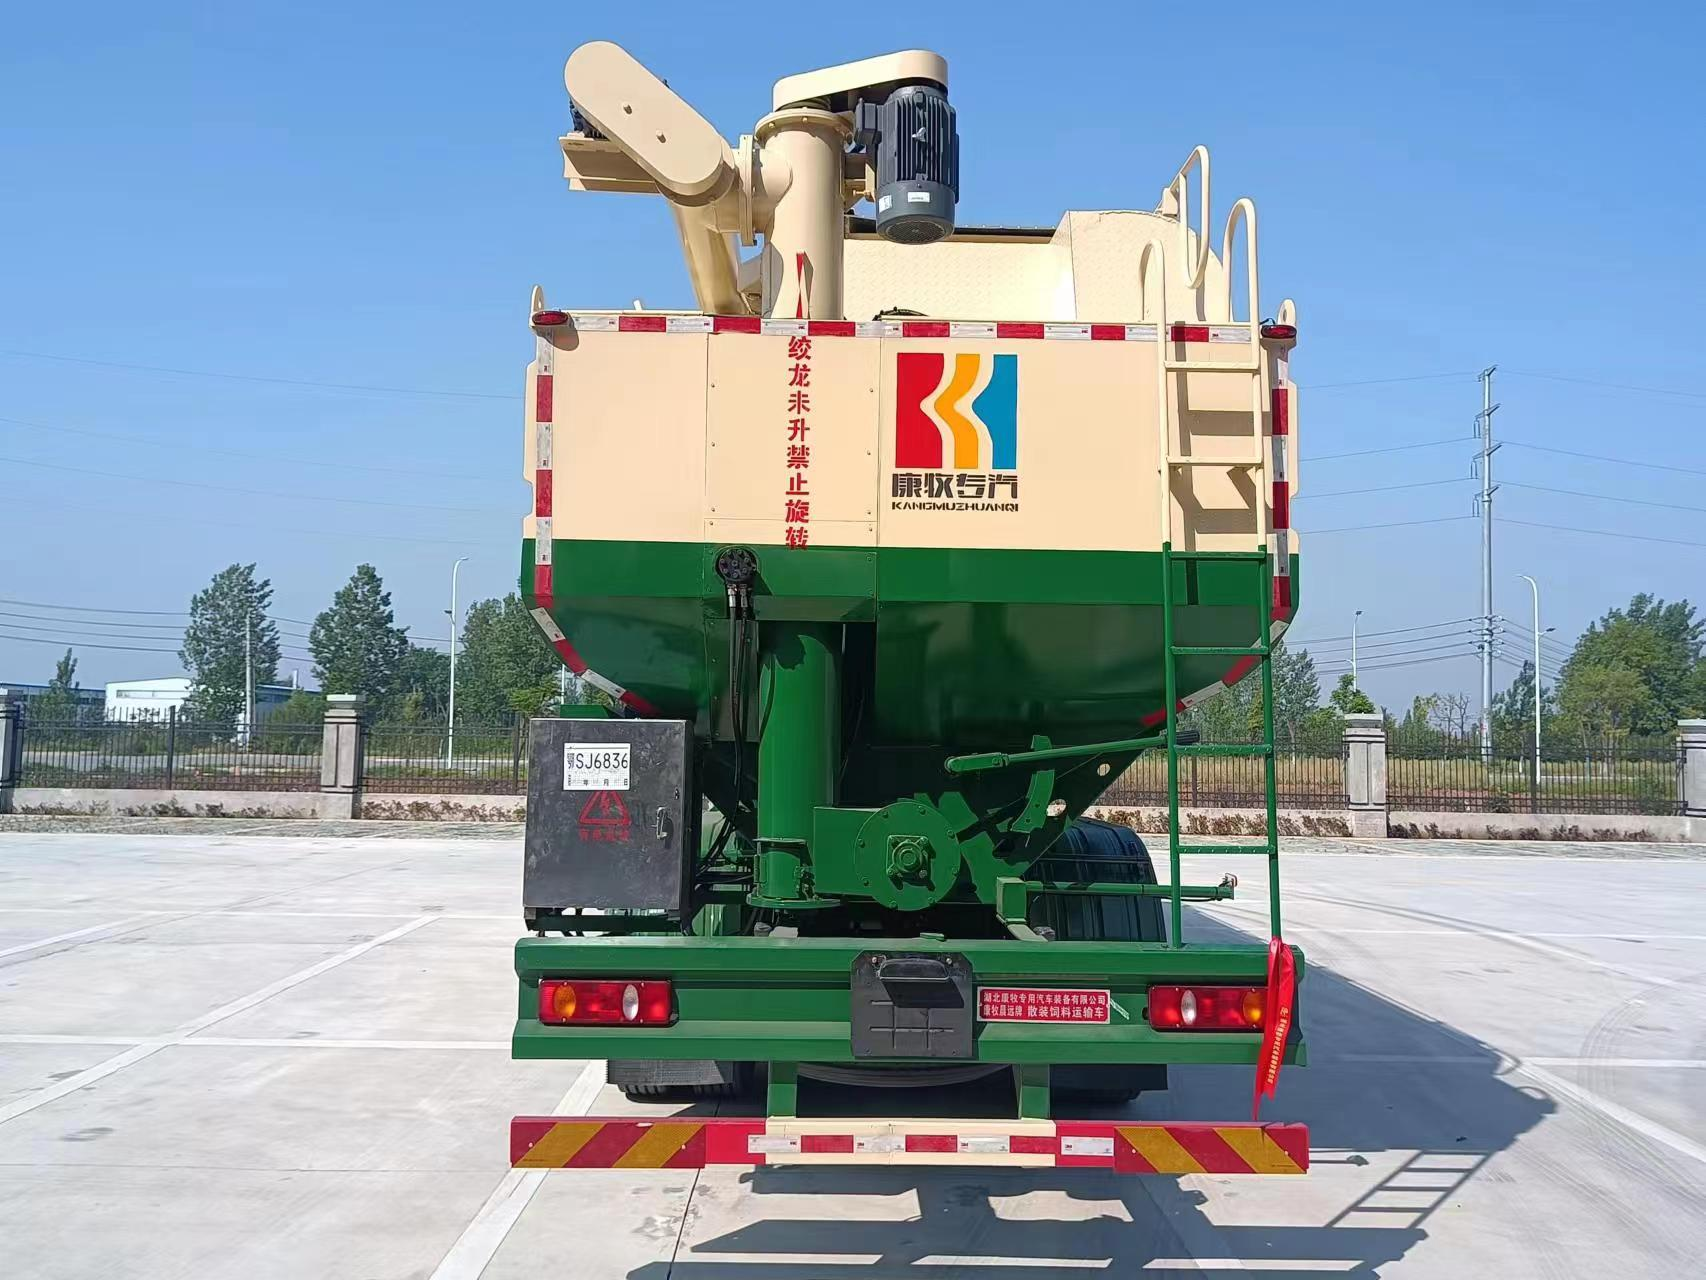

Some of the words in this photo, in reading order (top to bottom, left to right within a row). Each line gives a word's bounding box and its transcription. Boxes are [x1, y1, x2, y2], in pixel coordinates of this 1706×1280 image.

[785, 335, 812, 551] 绞龙未升禁止旋转
[891, 472, 1018, 499] 康牧专汽
[891, 501, 1019, 512] KANGMUZHUANQI
[1027, 1005, 1105, 1019] 散装饲料运输车
